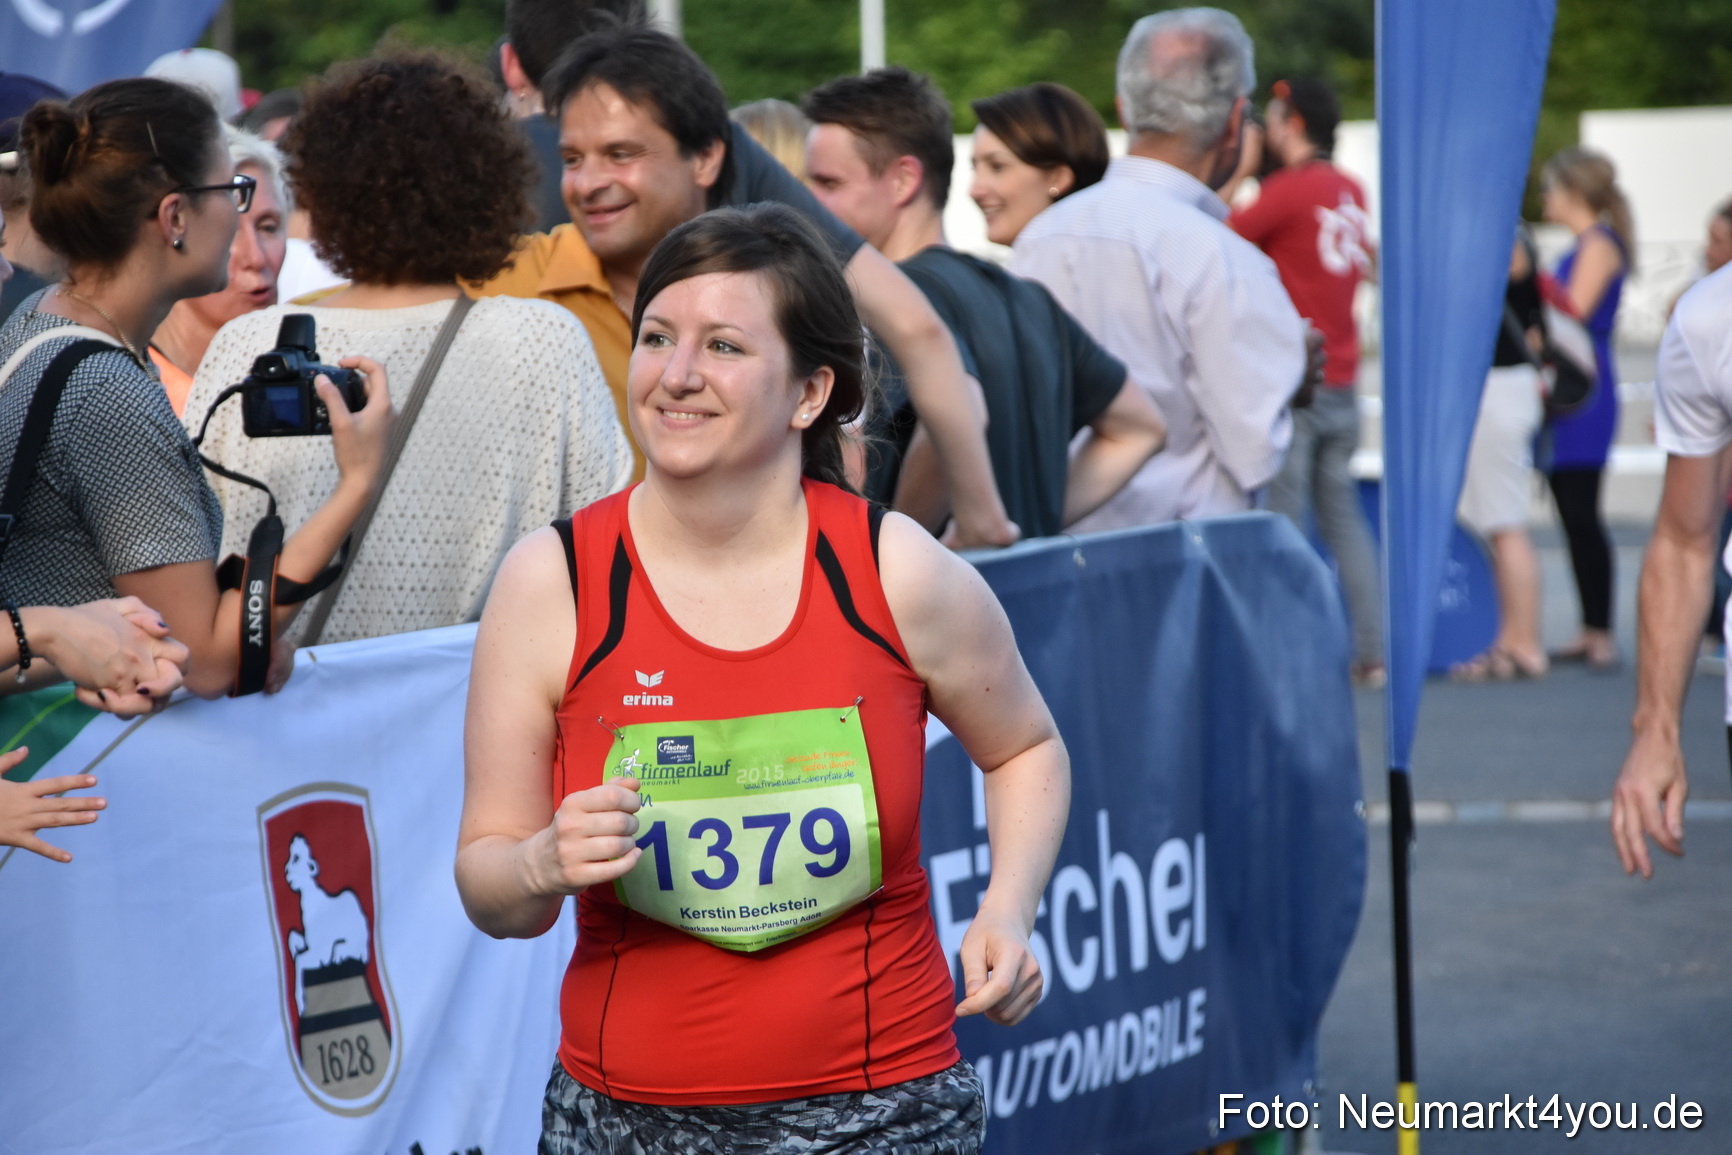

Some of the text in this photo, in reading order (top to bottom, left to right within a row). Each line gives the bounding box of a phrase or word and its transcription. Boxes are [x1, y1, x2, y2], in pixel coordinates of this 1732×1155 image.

[248, 580, 263, 647] SONY
[623, 691, 673, 706] erima
[641, 759, 785, 784] firmenlauf 2015
[635, 807, 851, 891] 1379
[680, 898, 818, 920] Kerstin Beckstein
[721, 917, 798, 933] Neumarkt-Parsberg
[316, 1034, 375, 1085] 1628
